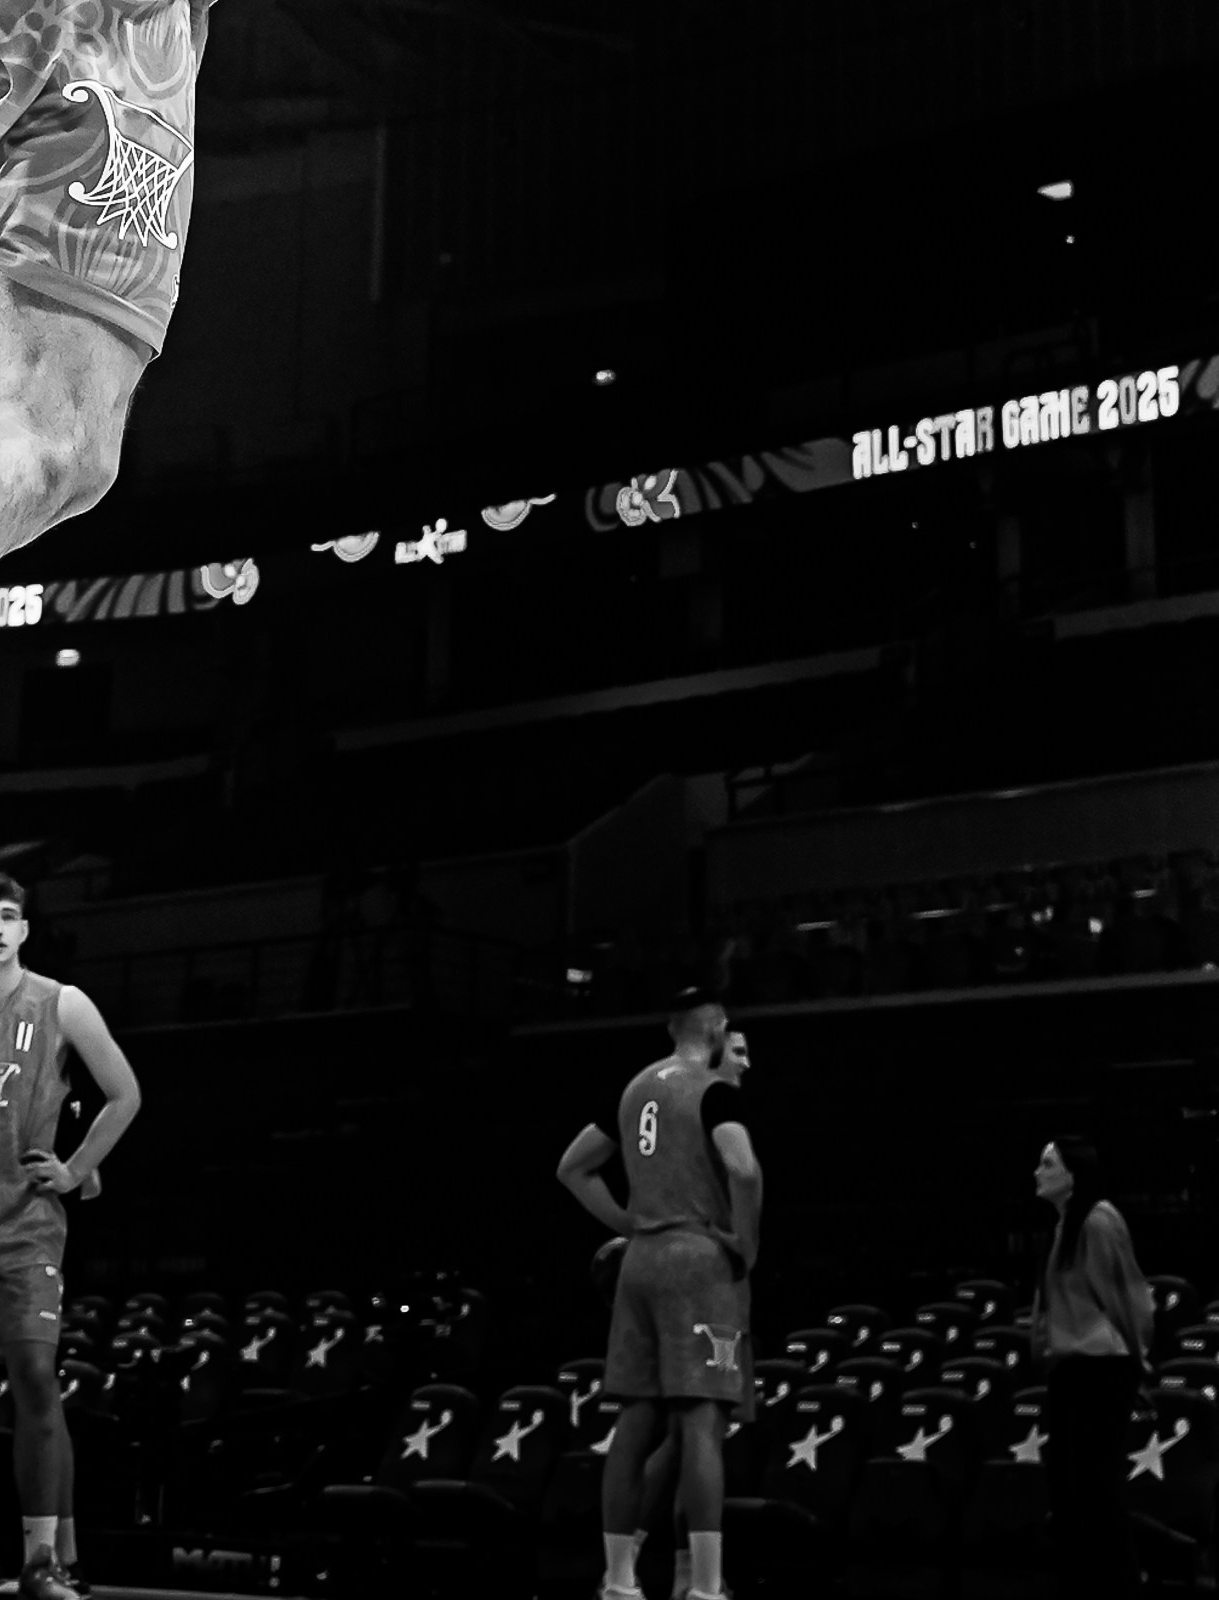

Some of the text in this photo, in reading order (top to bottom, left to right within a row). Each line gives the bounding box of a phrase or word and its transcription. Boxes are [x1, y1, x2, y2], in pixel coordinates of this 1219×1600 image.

[852, 365, 1180, 480] ALL-STAR GAME 2025
[15, 1020, 34, 1053] 11
